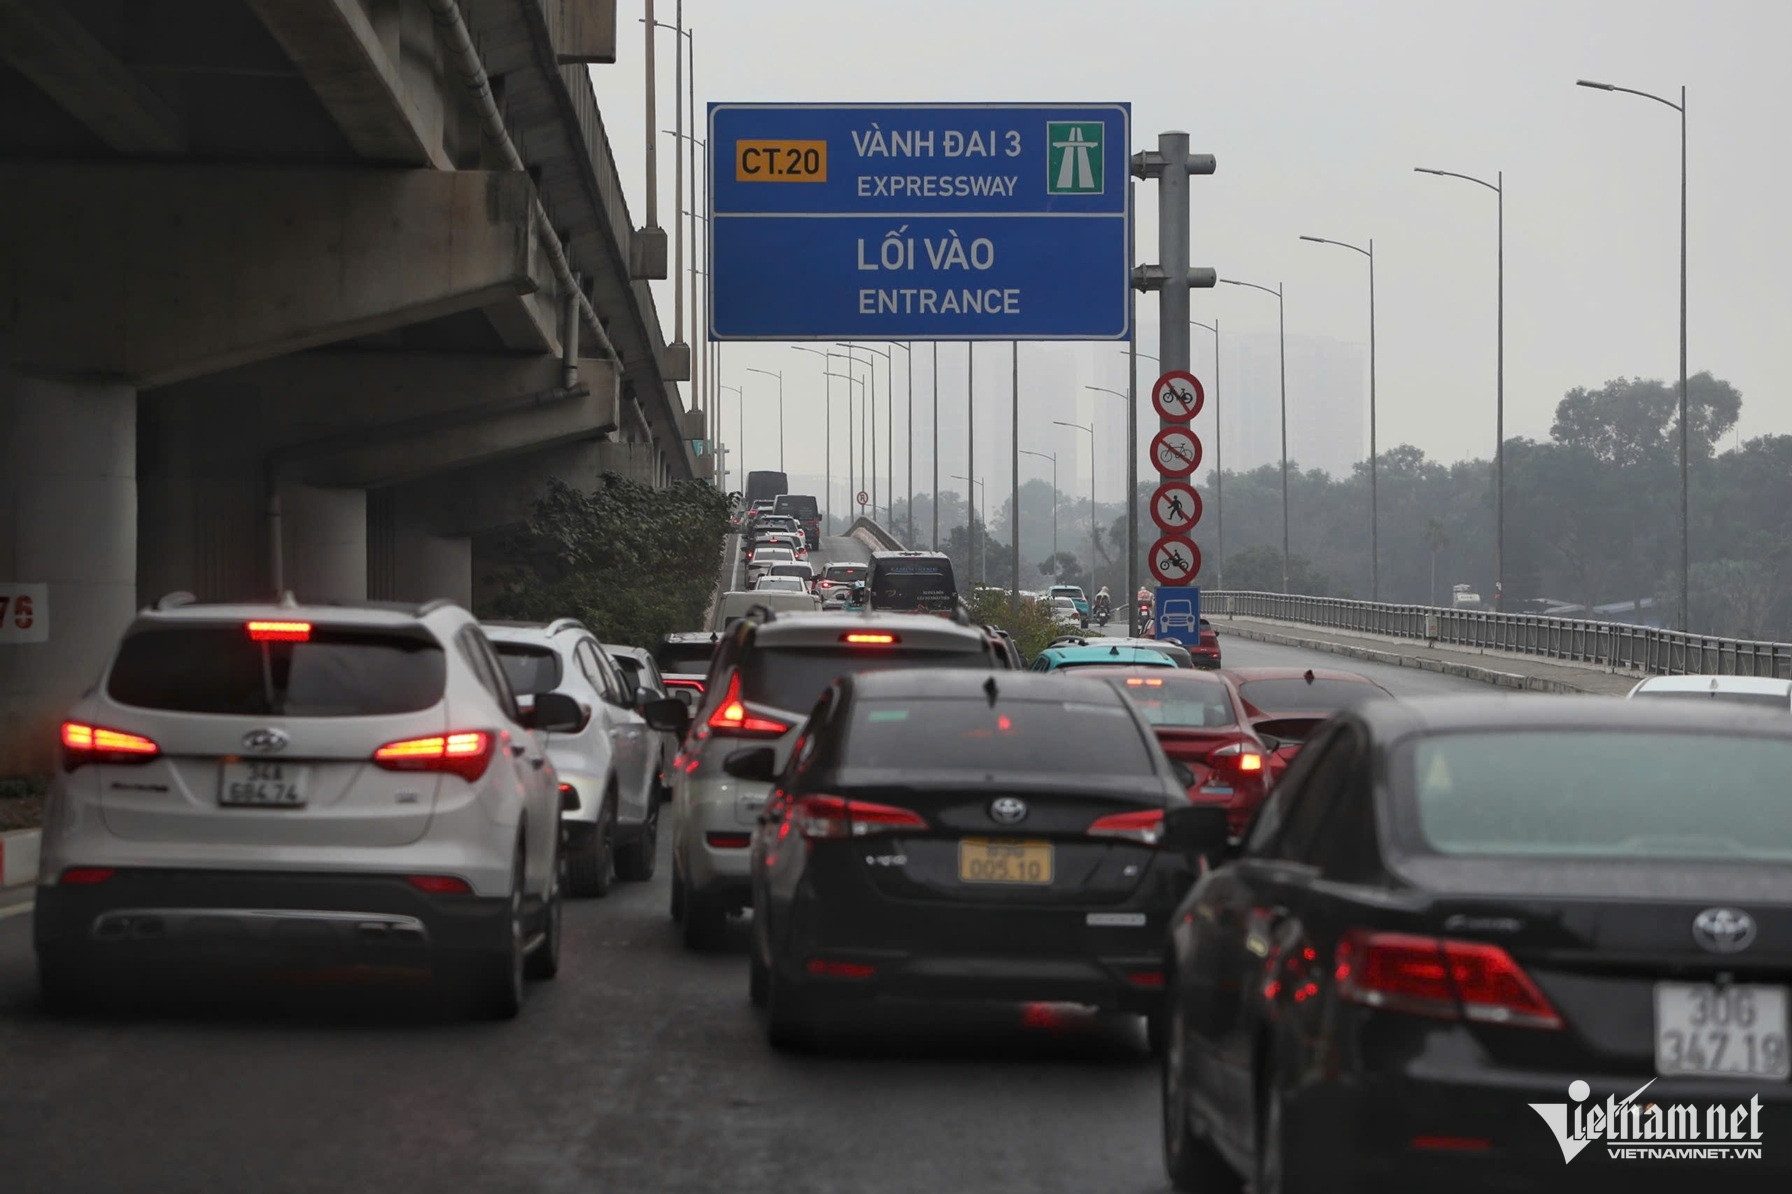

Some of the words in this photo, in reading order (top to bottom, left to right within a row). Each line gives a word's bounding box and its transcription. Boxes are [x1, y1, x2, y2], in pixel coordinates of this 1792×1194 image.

[851, 123, 934, 157] VÀNH
[943, 130, 997, 157] ĐAI
[1004, 130, 1022, 157] 3
[742, 148, 819, 175] CT.20
[857, 176, 1018, 196] EXPRESSWAY
[858, 225, 914, 270] LỐI
[924, 230, 995, 270] VÀO
[859, 289, 1020, 314] ENTRANCE
